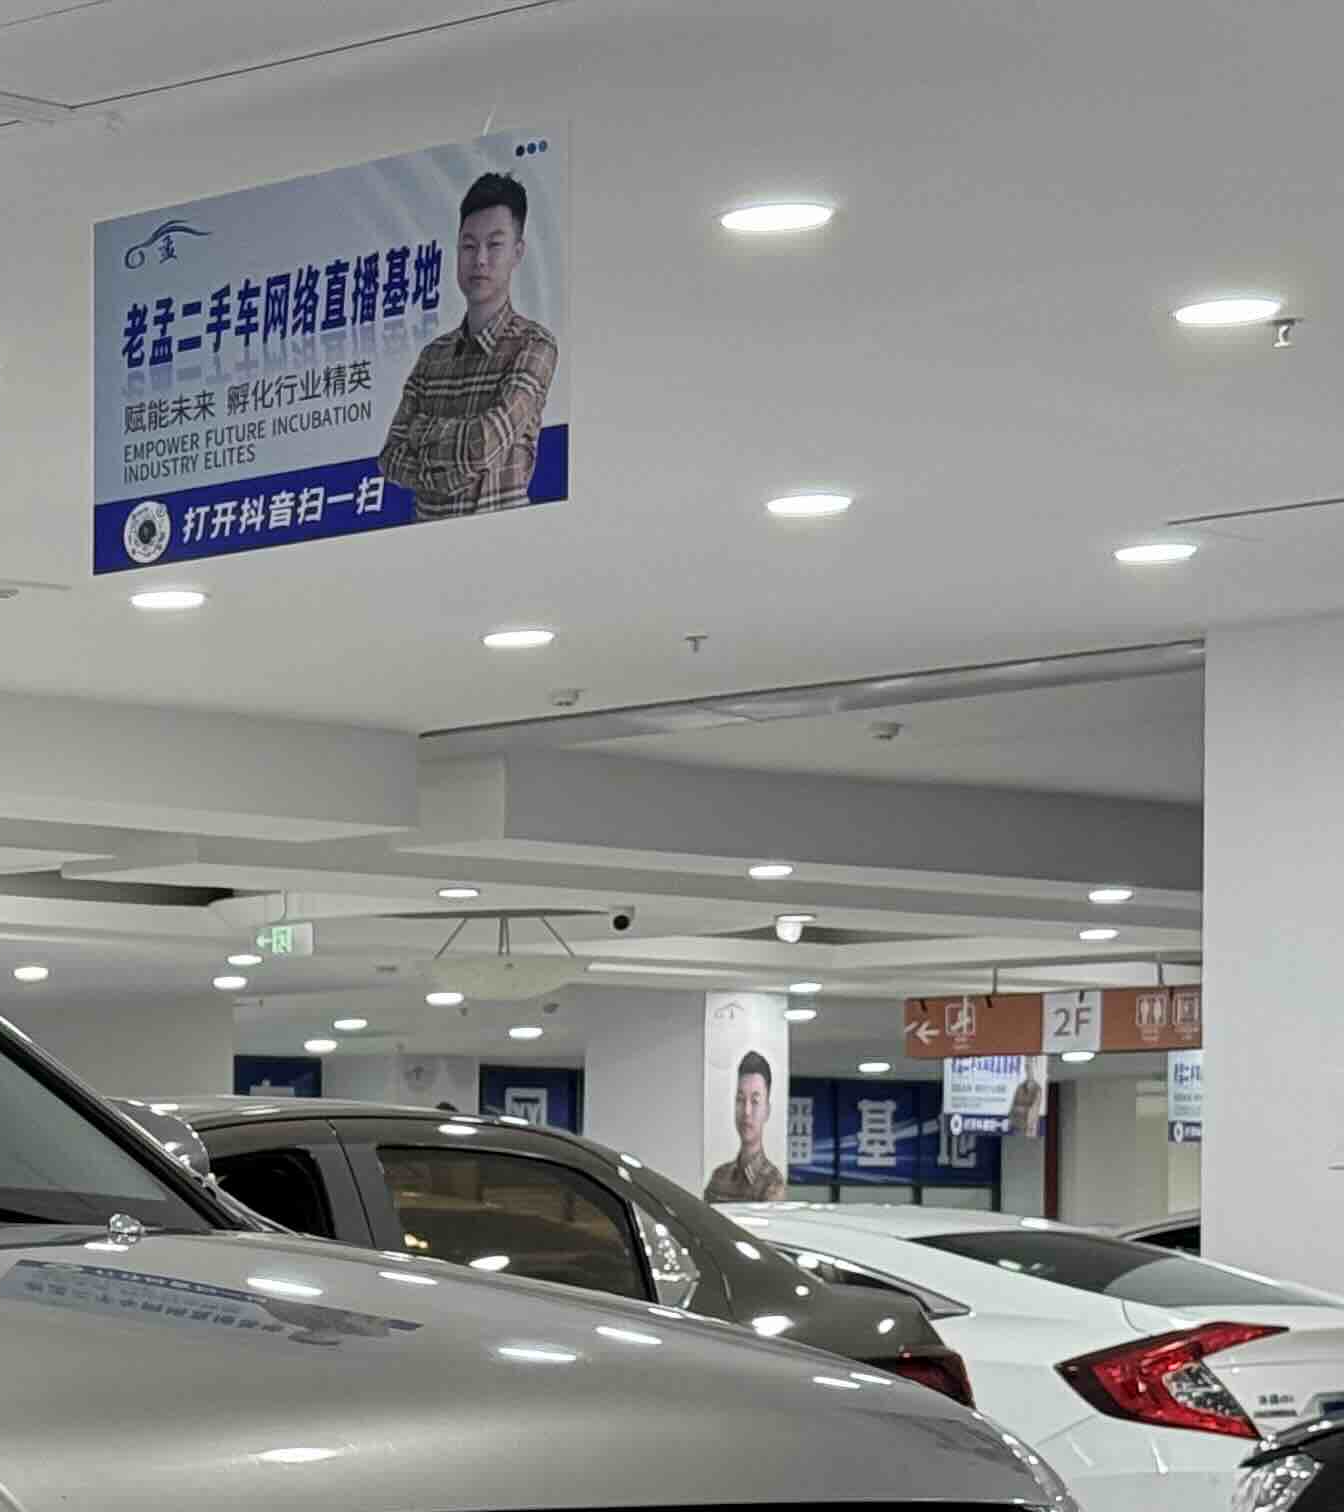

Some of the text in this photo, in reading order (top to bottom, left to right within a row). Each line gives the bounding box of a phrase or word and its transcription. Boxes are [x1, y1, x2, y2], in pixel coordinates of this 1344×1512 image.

[121, 239, 443, 369] 老孟二手车网络直播基地
[123, 360, 372, 435] 赋能未来 孵化行业精英
[123, 443, 257, 485] INDUSTRY ELITES
[124, 400, 372, 464] EMPOWER FUTURE INCUBATION
[182, 476, 385, 544] 打开抖音扫一扫
[1053, 1007, 1092, 1037] 2F
